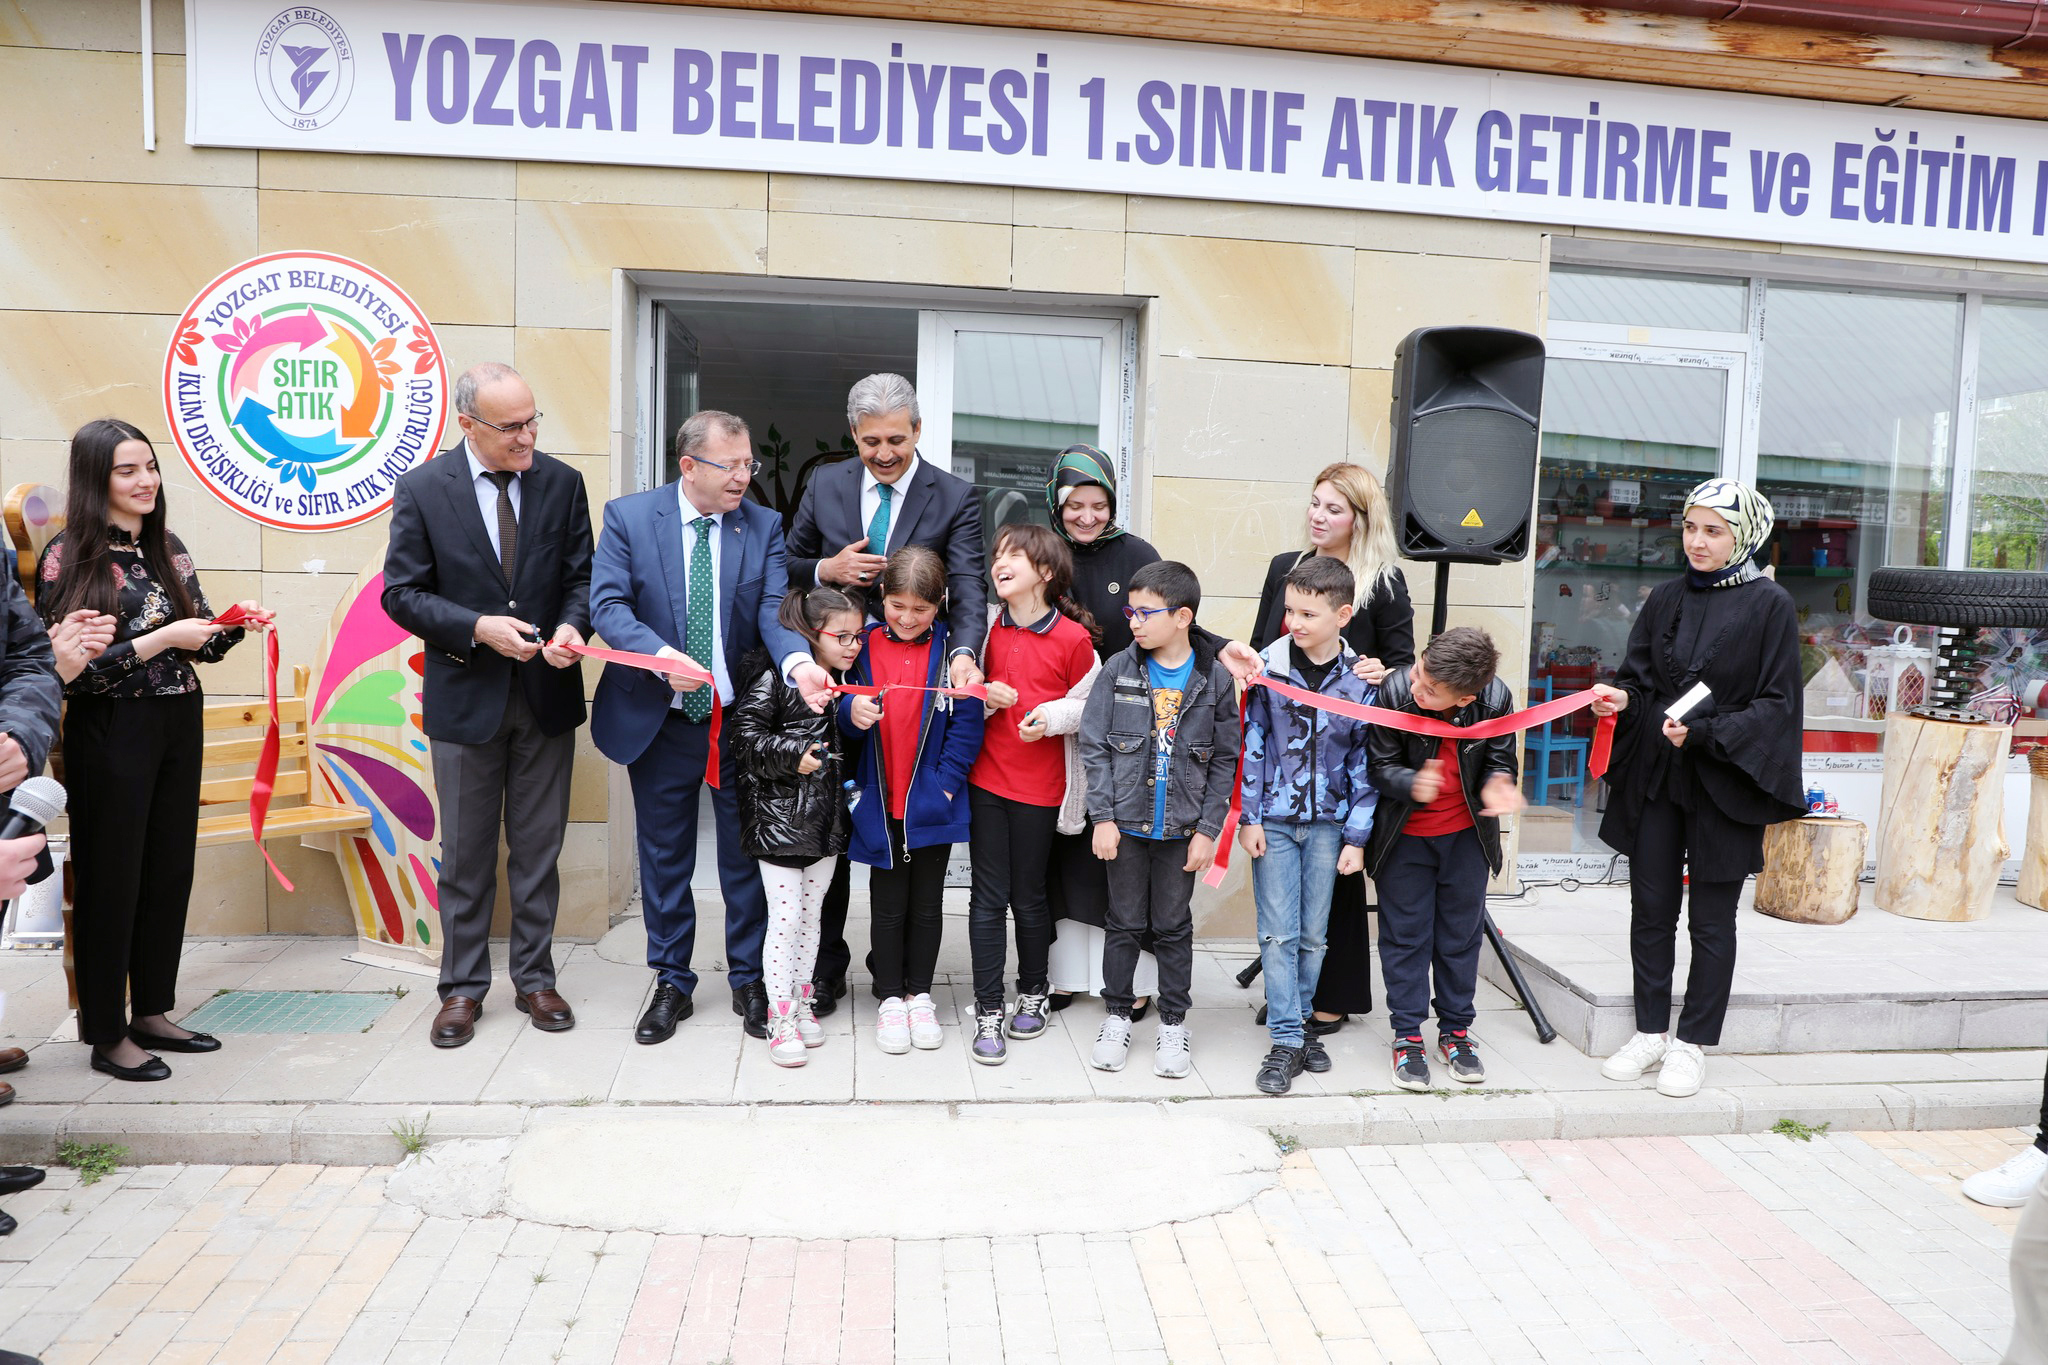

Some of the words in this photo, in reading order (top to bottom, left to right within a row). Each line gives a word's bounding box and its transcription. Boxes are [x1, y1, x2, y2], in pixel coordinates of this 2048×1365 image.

[259, 13, 291, 57] YOZGAT
[294, 9, 352, 61] BELEDİYESİ
[292, 117, 318, 129] 1874
[384, 32, 648, 131] YOZGAT
[673, 42, 1050, 157] BELEDİYESİ
[1321, 96, 1458, 187] ATIK
[1475, 101, 1731, 209] GETİRME
[1749, 149, 1811, 217] ve
[1830, 127, 2017, 234] EĞİTİM
[205, 272, 281, 328] YOZGAT
[288, 270, 409, 336] BELEDİYESİ
[273, 358, 339, 388] SIFIR
[178, 371, 207, 423] İKLİM
[277, 391, 335, 421] ATIK
[377, 379, 433, 486] MÜDÜRLÜĞÜ
[186, 423, 274, 508] DEĞİŞİKLİĞİ
[275, 496, 293, 515] ve
[297, 491, 344, 516] SIFIR
[345, 474, 386, 510] ATIK
